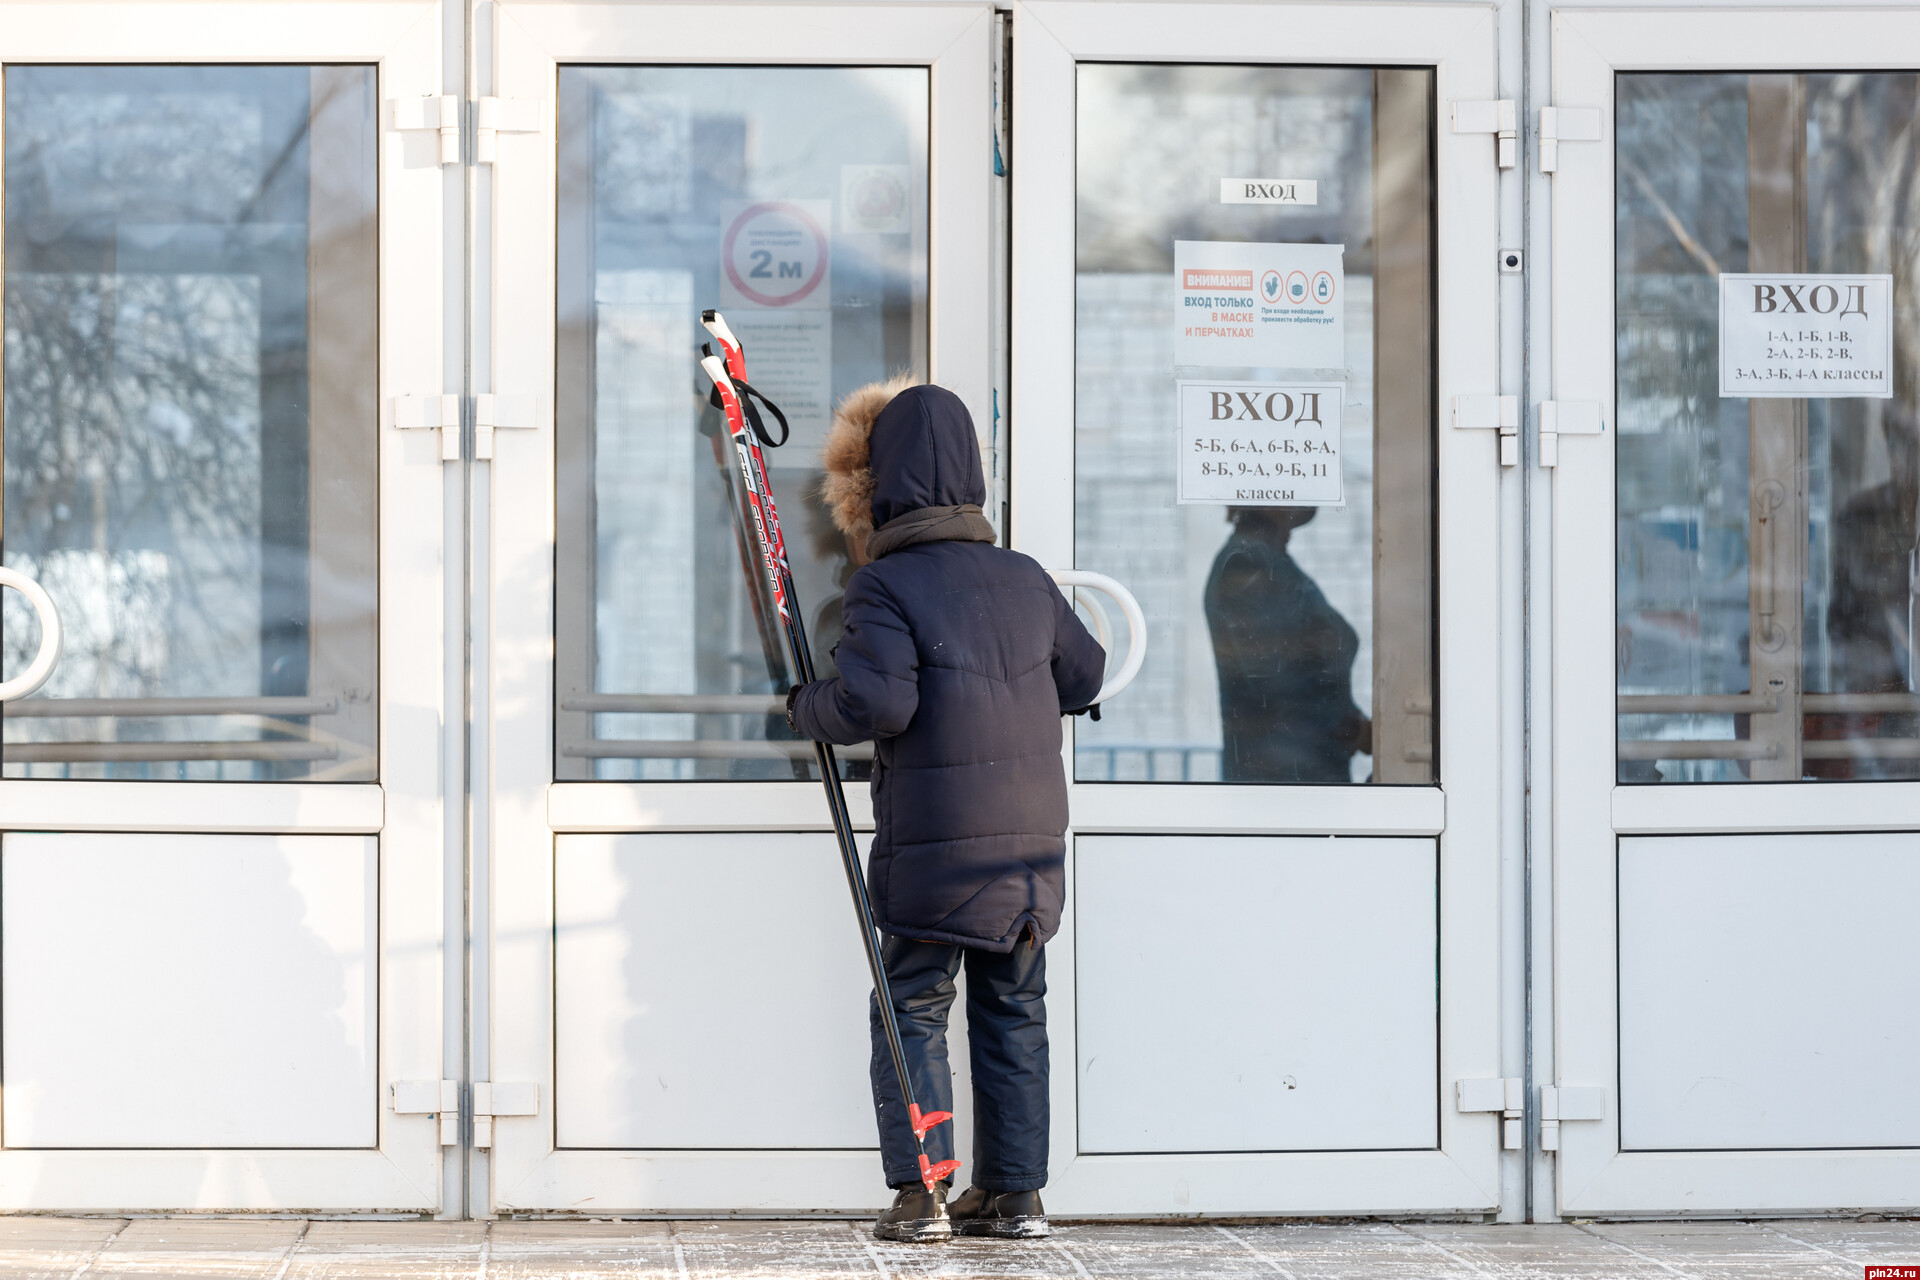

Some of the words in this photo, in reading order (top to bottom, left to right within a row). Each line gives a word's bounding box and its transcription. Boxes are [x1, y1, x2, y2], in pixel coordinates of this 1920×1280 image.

[1245, 184, 1296, 202] ВХОД
[749, 249, 773, 279] 2
[1187, 274, 1251, 288] ВНИМАНИЕ!
[1184, 296, 1212, 308] ВХОД
[1214, 297, 1254, 308] ТОЛЬКО
[1752, 284, 1868, 321] ВХОД
[1211, 312, 1218, 322] В
[1221, 312, 1254, 322] МАСКЕ
[1261, 307, 1272, 315] При
[1185, 327, 1192, 336] И
[1195, 327, 1254, 338] ПЕРЧАТКАХ!
[1767, 330, 1793, 343] 1-А,
[1798, 330, 1823, 343] 1-Б,
[1828, 331, 1853, 344] 1-В,
[1767, 348, 1793, 360] 2-А,
[1797, 348, 1823, 360] 2-Б,
[1827, 348, 1853, 361] 2-В,
[1735, 368, 1762, 380] 3-А,
[1765, 368, 1792, 381] 3-Б,
[1795, 368, 1818, 380] 4-А
[1823, 369, 1883, 380] классы
[1209, 391, 1322, 429] ВХОД
[1194, 438, 1226, 454] 5-Б,
[1230, 438, 1263, 453] 6-А,
[1267, 439, 1299, 454] 6-Б,
[1303, 440, 1336, 455] 8-А,
[1202, 461, 1233, 477] 8-Б,
[1238, 462, 1270, 477] 9-А,
[1275, 462, 1306, 478] 9-Б,
[1312, 463, 1327, 477] 11
[1236, 489, 1295, 500] классы
